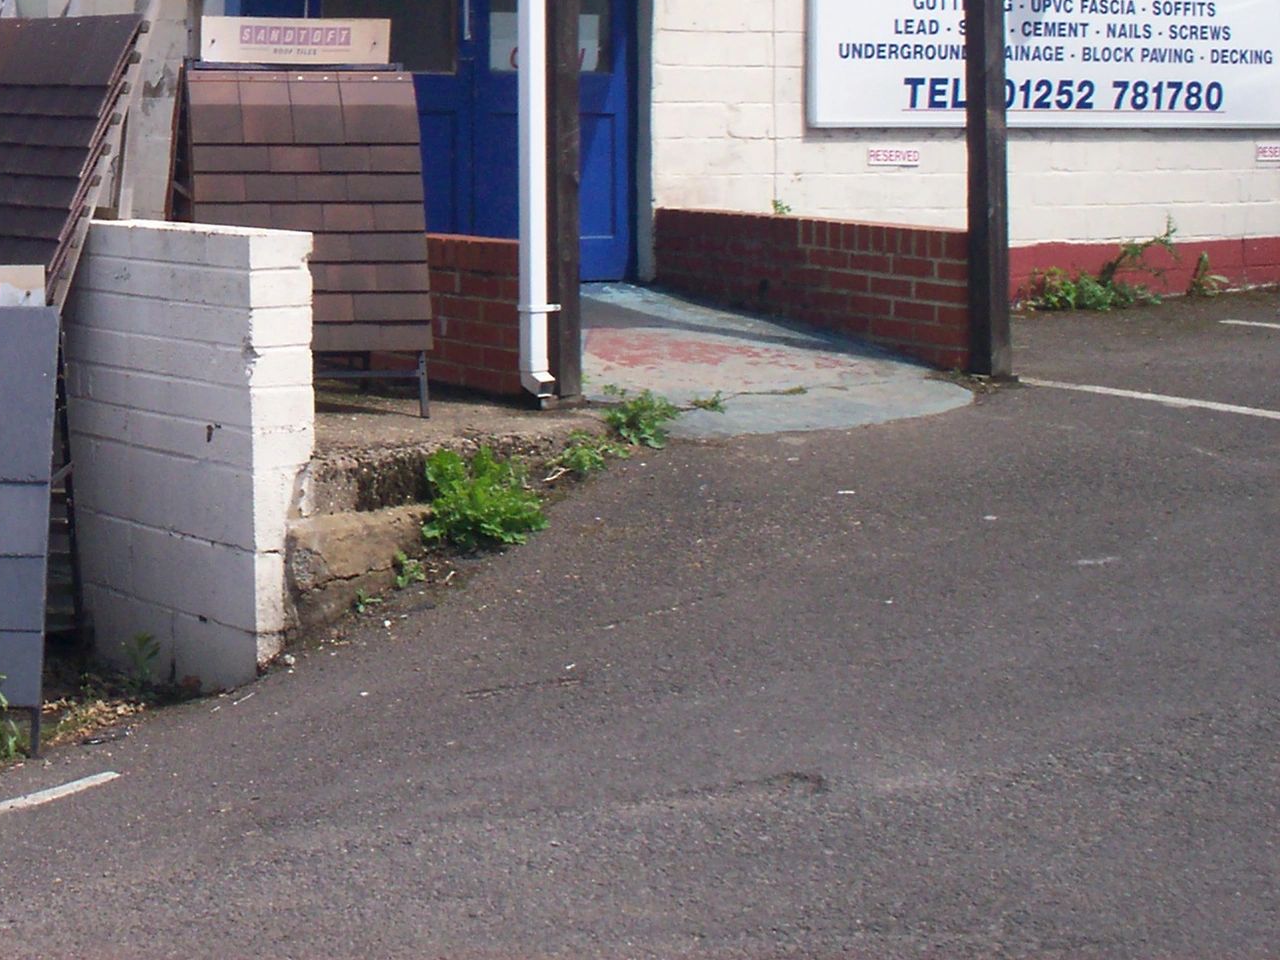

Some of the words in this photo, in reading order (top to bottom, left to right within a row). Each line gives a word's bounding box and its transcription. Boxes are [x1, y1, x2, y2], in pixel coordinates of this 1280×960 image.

[1152, 0, 1217, 17] SOFFITS
[240, 26, 351, 45] SANDTOFT
[893, 19, 940, 37] LEAD
[1021, 21, 1090, 39] CEMENT
[1106, 23, 1152, 40] NAILS
[1168, 24, 1232, 42] SCREWS
[1004, 45, 1064, 62] AINAGE
[1081, 46, 1135, 63] BLOCK
[1140, 47, 1195, 64] PAVING
[1210, 48, 1274, 66] DECKING
[1111, 80, 1224, 112] 781780
[869, 149, 920, 162] RESERVED
